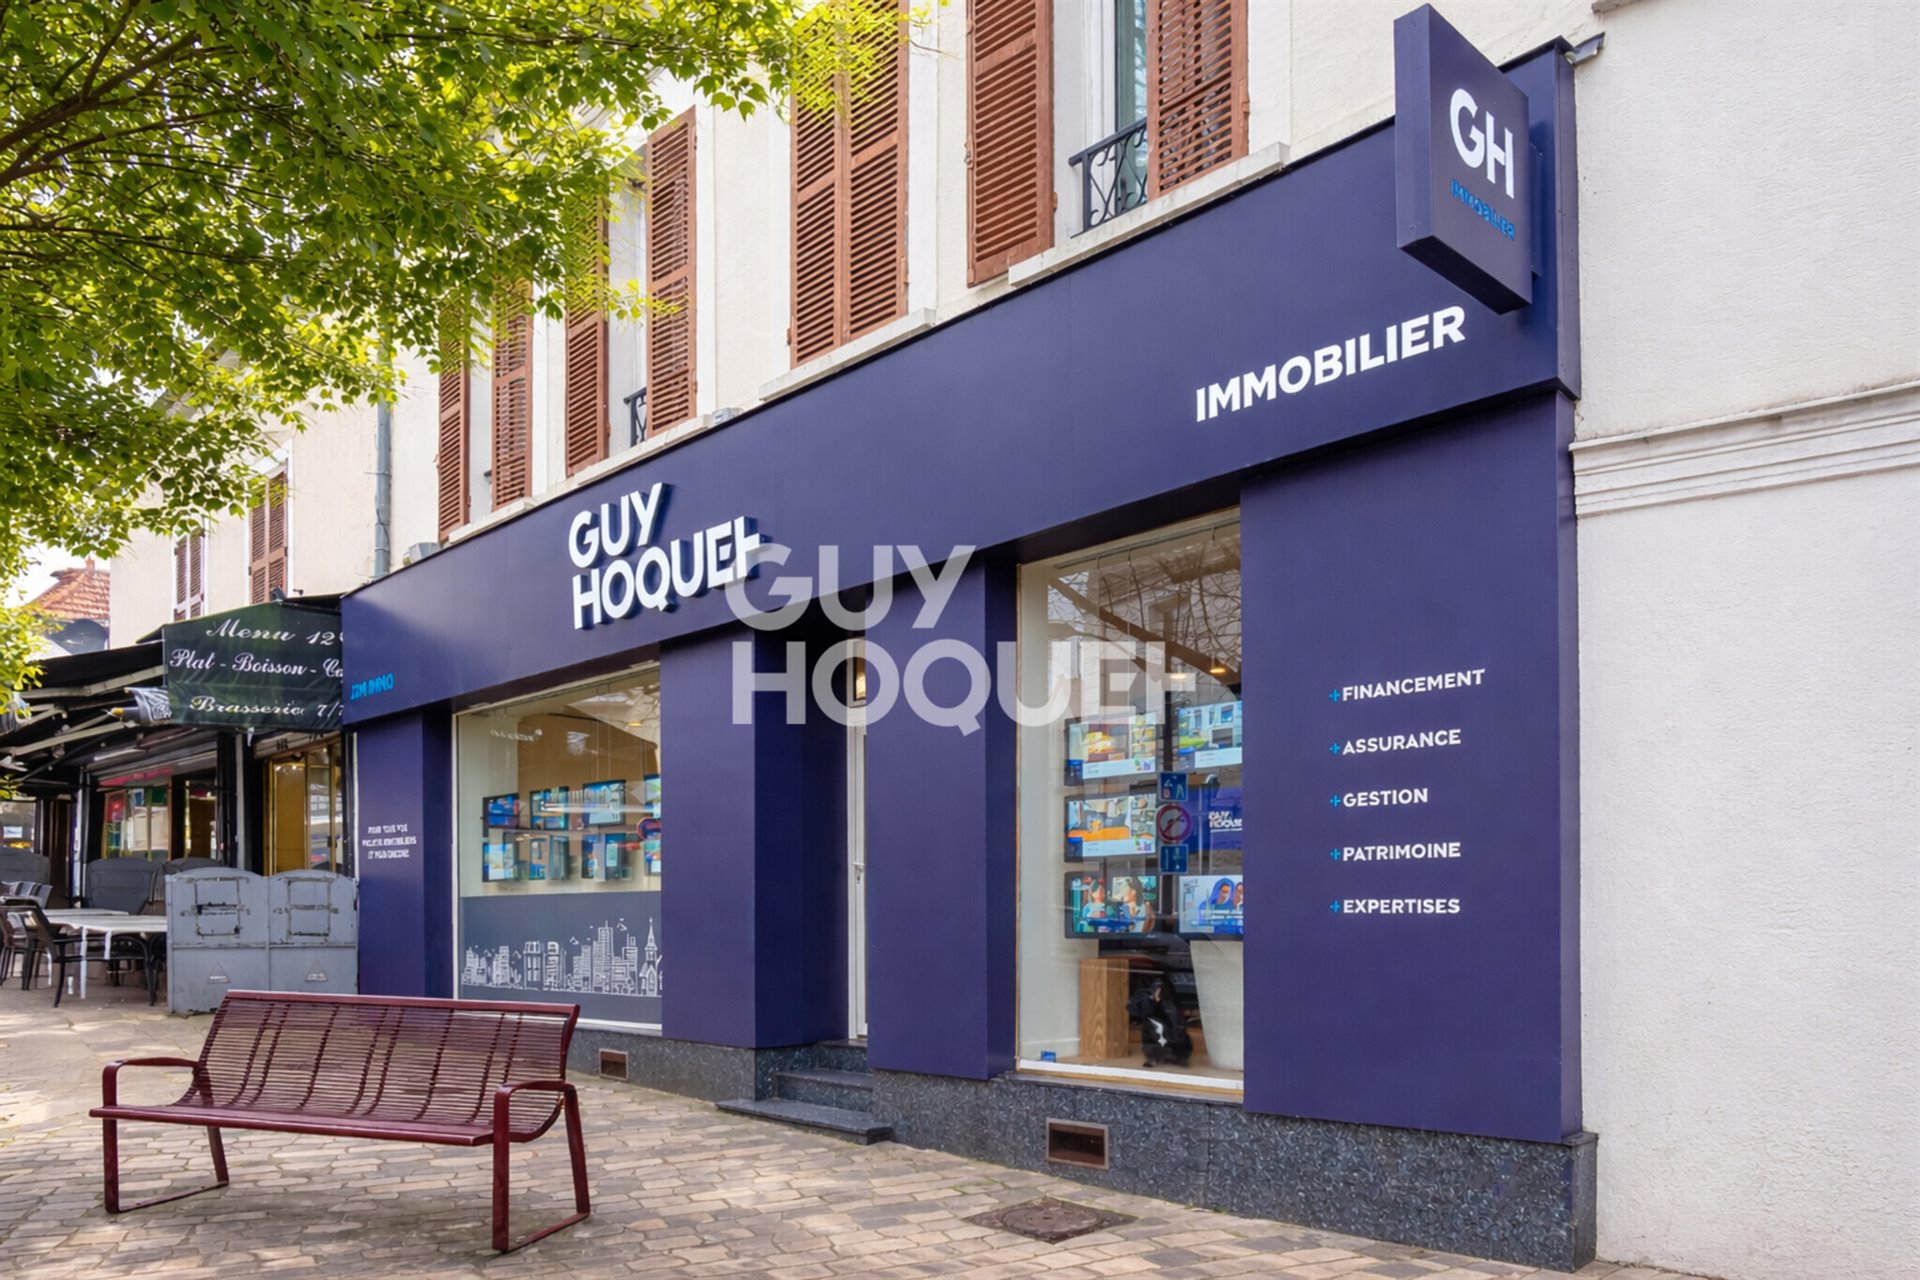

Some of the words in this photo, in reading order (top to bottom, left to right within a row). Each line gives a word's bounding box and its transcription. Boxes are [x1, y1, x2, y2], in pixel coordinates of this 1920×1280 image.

[1450, 88, 1514, 199] GH
[1196, 305, 1465, 422] IMMOBILIER
[568, 482, 663, 568] GUY
[572, 516, 760, 630] HOQUET
[206, 619, 296, 642] Menu
[170, 649, 216, 670] Plat
[232, 652, 308, 675] Boisson
[1342, 669, 1486, 702] FINANCEMENT
[1342, 729, 1462, 756] ASSURANCE
[1342, 788, 1429, 808] GESTION
[1342, 842, 1462, 862] PATRIMOINE
[1342, 899, 1461, 914] EXPERTISES
